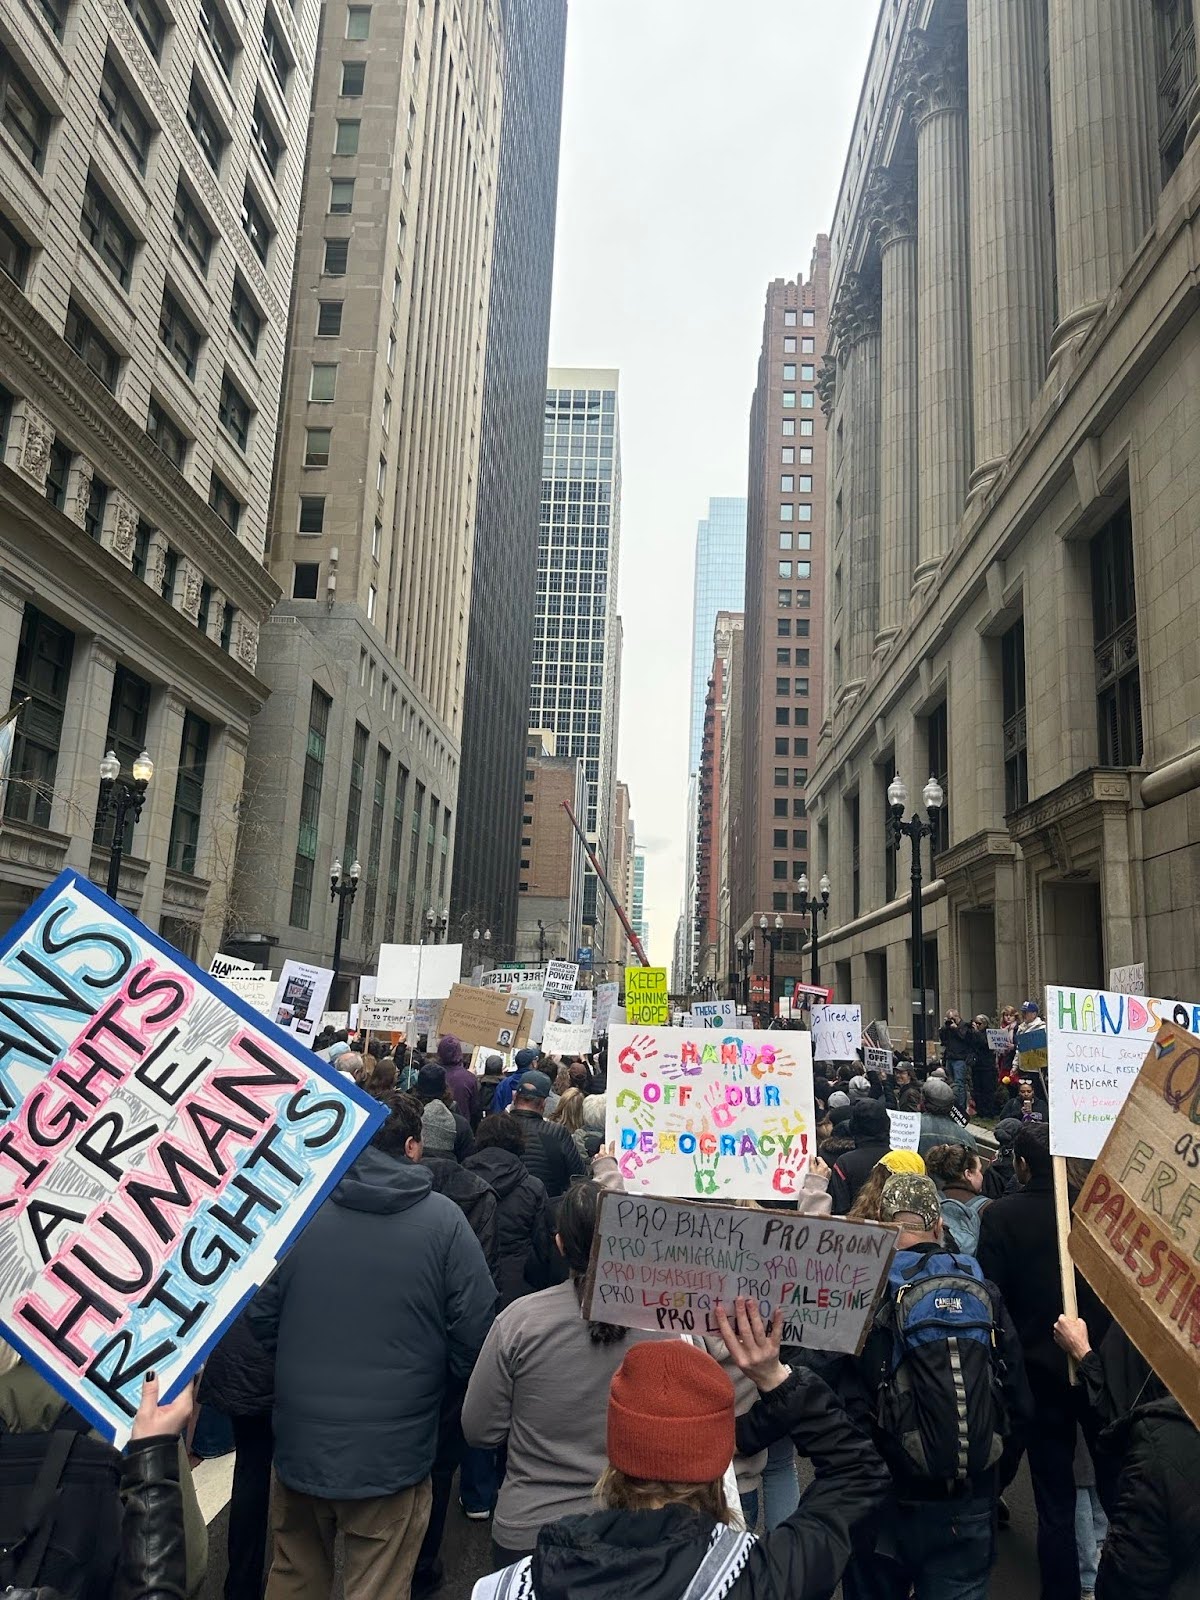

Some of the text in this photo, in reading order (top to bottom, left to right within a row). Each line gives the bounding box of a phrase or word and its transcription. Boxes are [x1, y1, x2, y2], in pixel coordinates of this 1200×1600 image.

[549, 971, 574, 981] POWER
[550, 961, 577, 970] WORKERS
[547, 981, 560, 989] NOT
[629, 971, 666, 990] KEEP
[627, 991, 667, 1005] SHINING
[631, 1005, 667, 1023] HOPE
[694, 1004, 731, 1016] THERE IS
[821, 1005, 849, 1023] Tired
[1058, 989, 1162, 1034] HANDS
[681, 1042, 777, 1066] HANDS
[868, 1053, 888, 1063] OFF!
[1066, 1042, 1111, 1058] SOCIAL
[1066, 1062, 1113, 1075] MEDICAL
[643, 1082, 781, 1107] OFF OUR
[890, 1113, 915, 1121] SILENCE
[27, 1026, 211, 1265] ARE
[620, 1128, 808, 1157] DEMOCRACY!
[20, 1036, 301, 1369] HUMAN
[617, 1200, 889, 1263] PRO BLACK PRO BROWN
[85, 1089, 346, 1419] RIGHTS
[606, 1235, 871, 1290] PRO IMMIGRANTS PRO CHOICE
[601, 1260, 635, 1285] PRO
[640, 1265, 729, 1295] DISABILITY
[737, 1276, 771, 1300] PRO
[780, 1281, 875, 1310] PALESTINE
[599, 1283, 635, 1307] PRO
[642, 1289, 724, 1312] LGBTQ+
[656, 1307, 696, 1331] PRO
